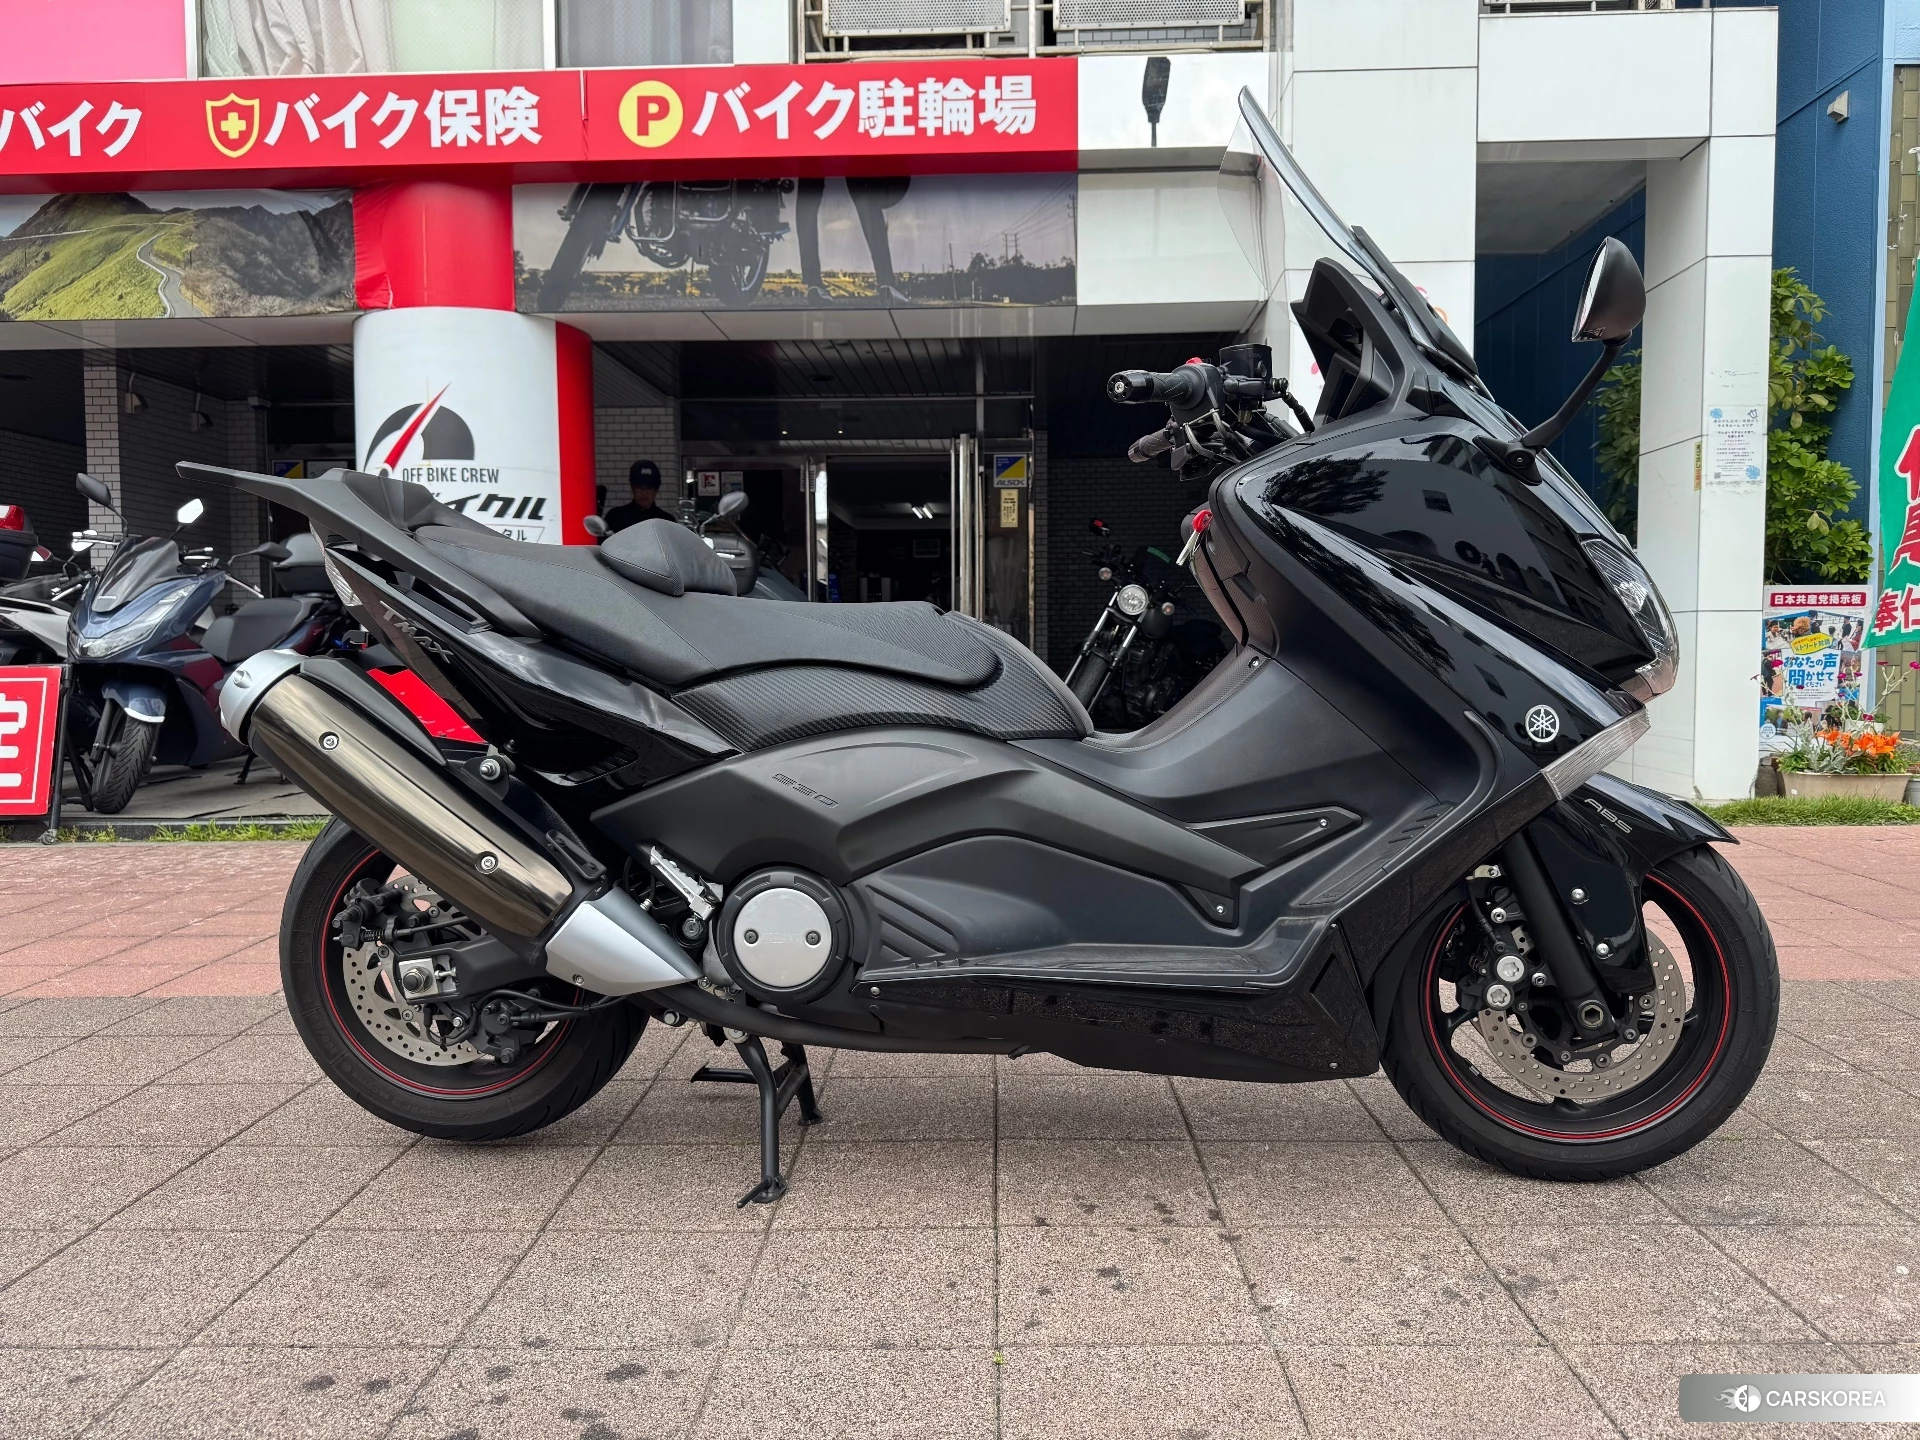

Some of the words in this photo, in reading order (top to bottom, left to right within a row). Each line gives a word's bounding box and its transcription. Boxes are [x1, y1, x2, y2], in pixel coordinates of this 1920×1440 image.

[263, 86, 543, 150] バイク保険
[637, 95, 670, 136] P
[691, 75, 1037, 140] バイク駐輪場
[0, 100, 142, 158] バイク
[402, 467, 423, 482] OFF
[427, 468, 457, 482] BIKE
[461, 467, 500, 484] CREW
[1774, 594, 1862, 605] 日本共産党掲示板
[380, 600, 455, 664] TMAX
[1784, 653, 1839, 670] あなたの声
[772, 773, 839, 808] 530
[1584, 798, 1633, 834] ABS
